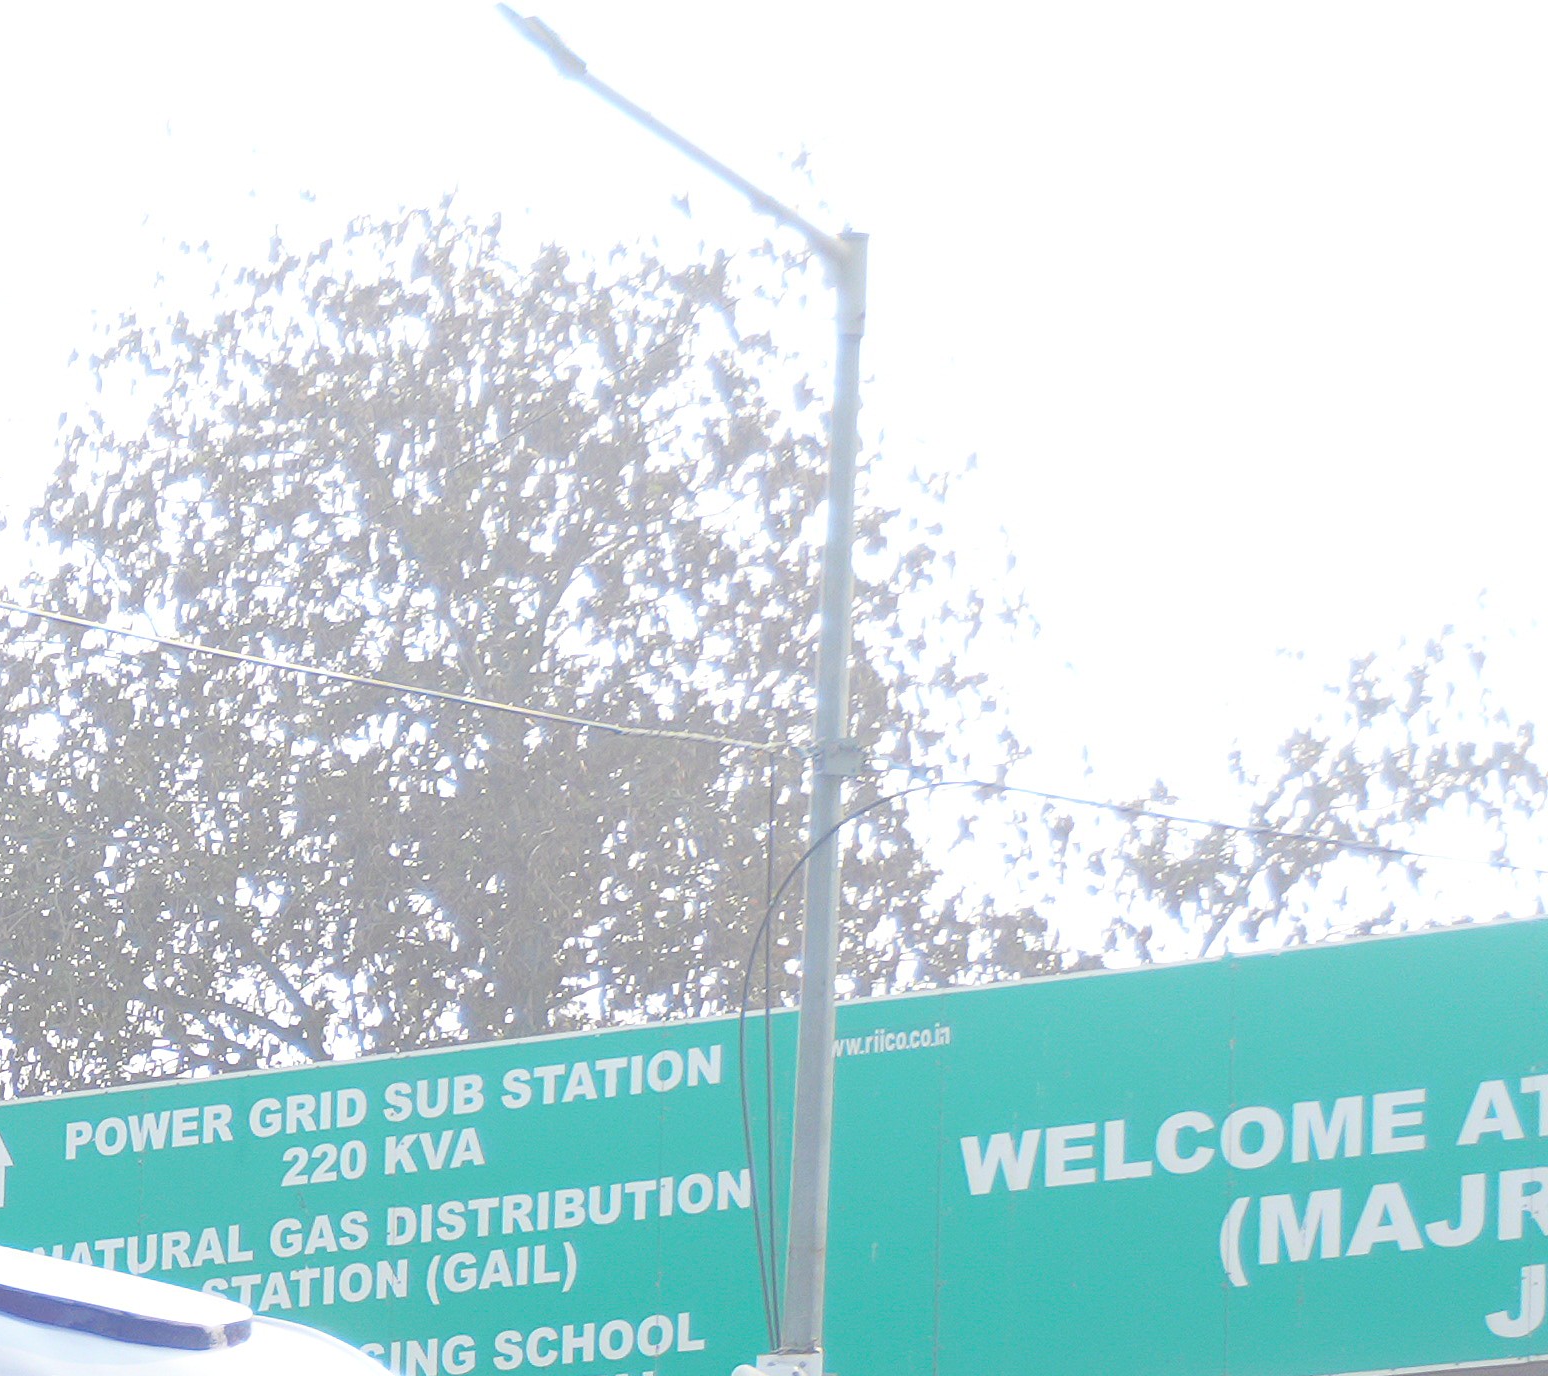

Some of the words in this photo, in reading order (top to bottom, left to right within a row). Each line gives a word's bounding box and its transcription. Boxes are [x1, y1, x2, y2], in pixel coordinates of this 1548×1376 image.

[65, 1102, 233, 1161] POWER
[249, 1089, 368, 1140] GRID
[383, 1077, 485, 1121] SUB
[501, 1044, 723, 1110] STATION
[960, 1088, 1427, 1196] WELCOME
[281, 1143, 368, 1189] 220
[384, 1128, 485, 1176] KVA
[33, 1224, 253, 1277] ATURAL
[269, 1211, 369, 1259] GAS
[387, 1168, 753, 1247] DISTRIBUTION
[425, 1241, 577, 1306] (GAIL)
[493, 1312, 706, 1371] SCHOOL
